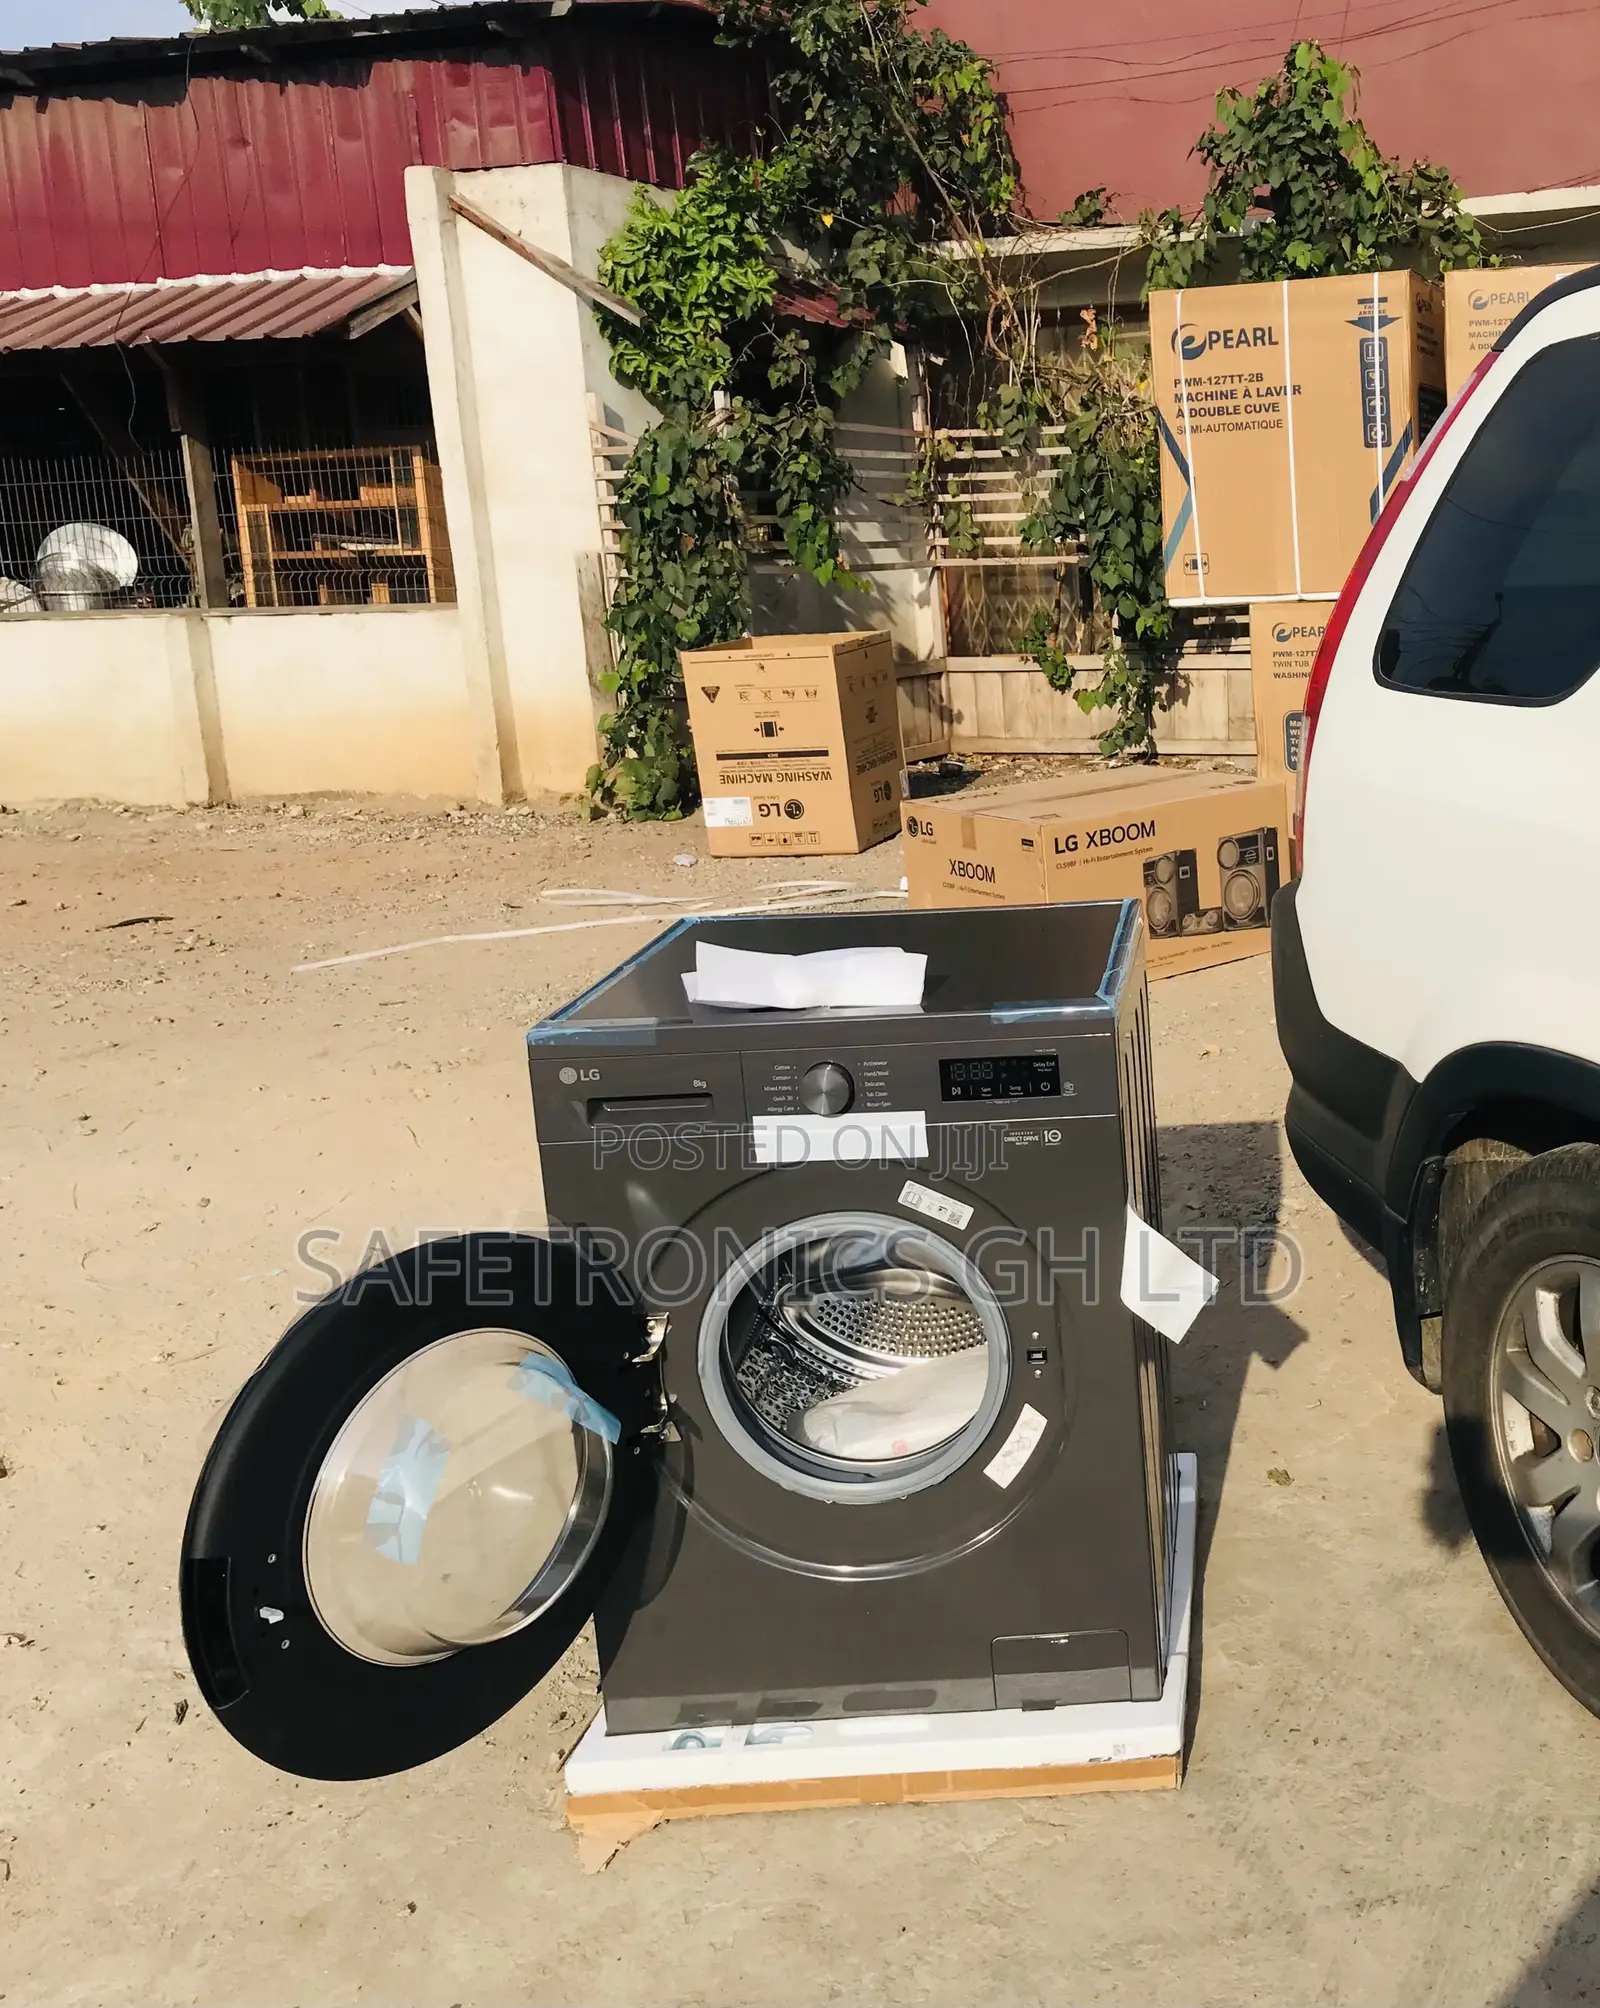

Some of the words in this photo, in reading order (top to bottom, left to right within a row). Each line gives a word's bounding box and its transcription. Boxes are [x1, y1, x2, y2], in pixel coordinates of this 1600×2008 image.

[1208, 326, 1279, 350] PEARL
[1174, 373, 1264, 388] PWM-127TT-2B
[1174, 389, 1238, 403] MACHINE
[1243, 385, 1252, 399] À
[1176, 405, 1185, 419] À
[1189, 405, 1241, 418] DOUBLE
[1244, 402, 1281, 415] CUVE
[1272, 650, 1317, 658] PWM-127T
[1272, 660, 1293, 668] TWIN
[1294, 660, 1310, 668] TUB
[719, 772, 773, 785] MACHINE
[776, 771, 833, 783] WASHING
[873, 786, 884, 803] LG
[758, 803, 781, 817] LG
[919, 820, 934, 836] LG
[1054, 834, 1079, 854] LG
[1085, 820, 1156, 849] XBOOM
[1096, 850, 1134, 862] Entertainment
[1134, 846, 1154, 856] System
[948, 859, 996, 883] XBOOM
[580, 1069, 601, 1081] LG
[693, 1079, 707, 1089] 8kg
